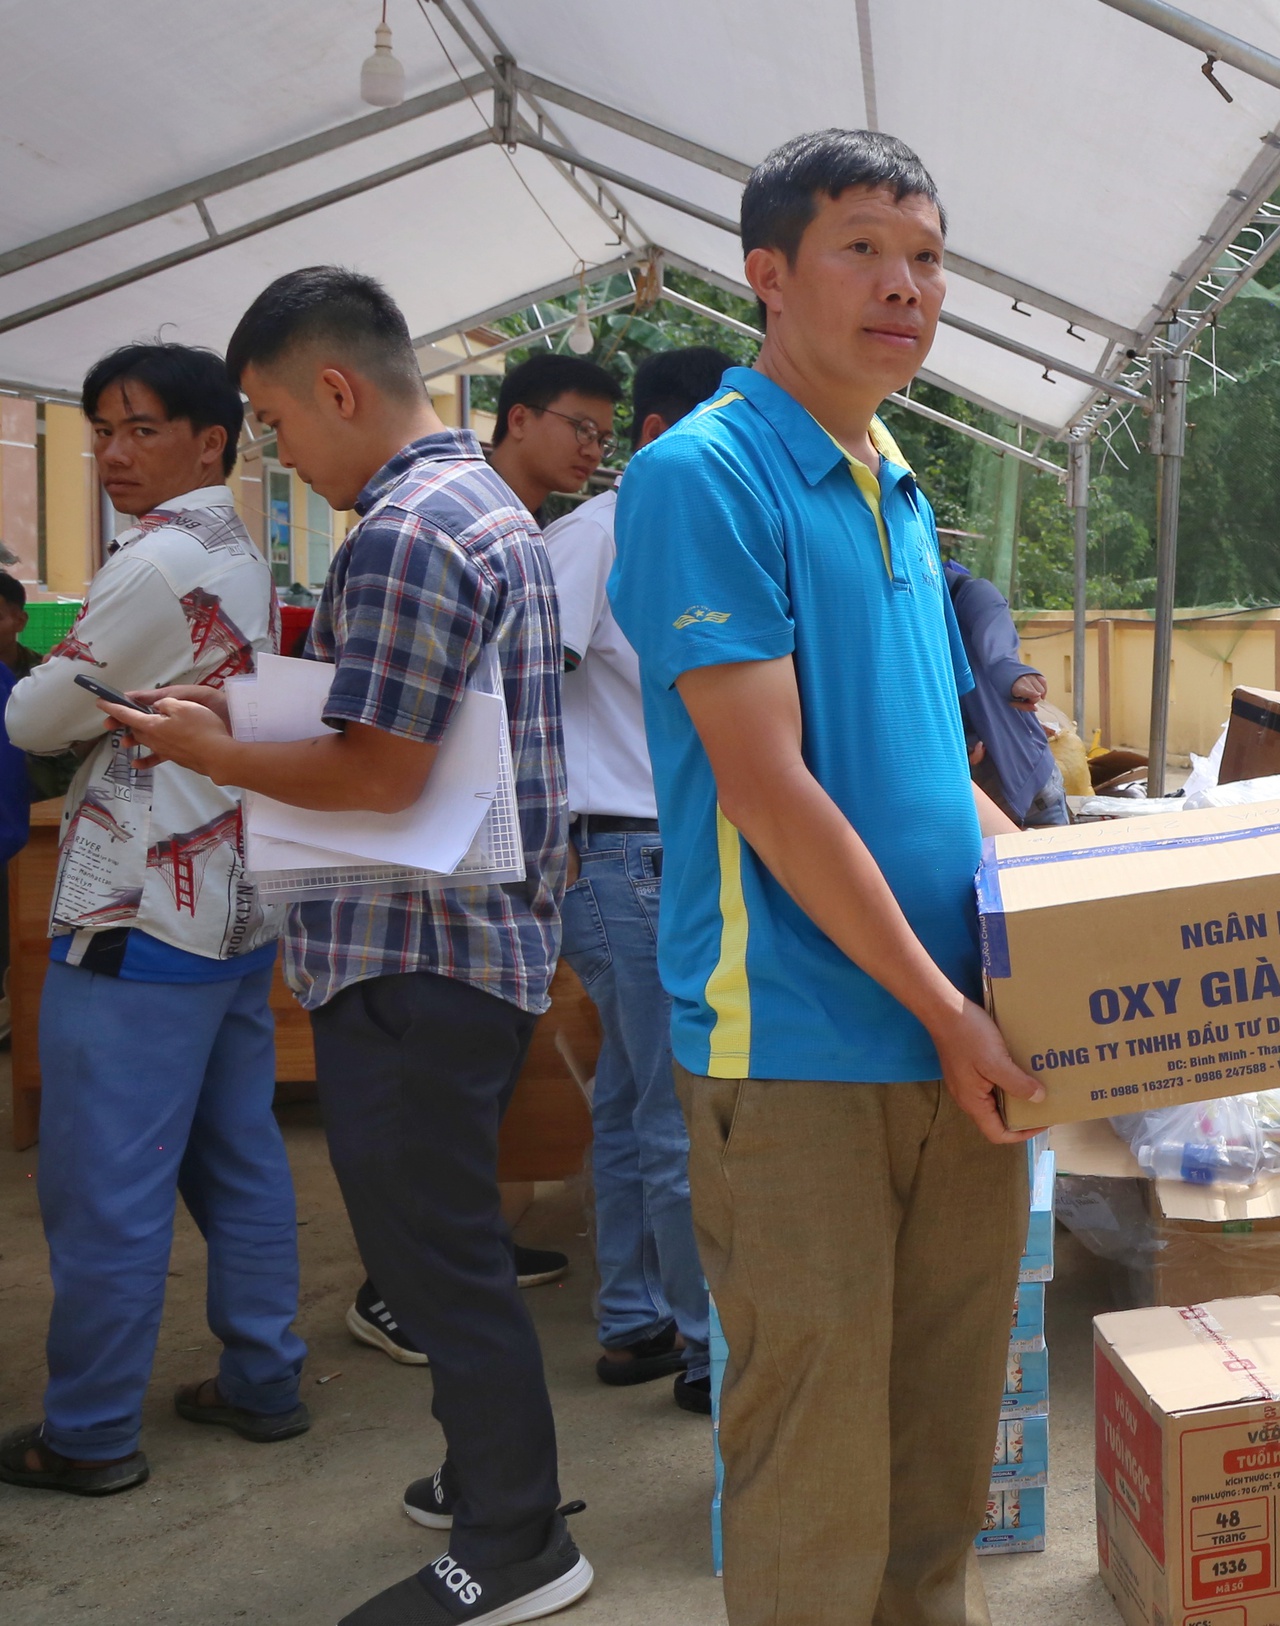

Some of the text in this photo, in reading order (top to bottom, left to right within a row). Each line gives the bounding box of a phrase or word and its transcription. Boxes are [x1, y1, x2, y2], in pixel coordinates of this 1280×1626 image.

[76, 835, 102, 852] RIVER
[79, 868, 112, 886] Manhattan
[1180, 912, 1268, 949] NGÂN
[1089, 977, 1182, 1025] OXY
[1031, 1047, 1090, 1072] CÔNG
[1095, 1042, 1120, 1061] TY
[1125, 1032, 1182, 1057] TNHH
[1235, 1017, 1262, 1039] TƯ
[1168, 1060, 1187, 1071] ĐC:
[1219, 1049, 1247, 1063] Minh
[1091, 1089, 1108, 1101] ĐT:
[1111, 1084, 1139, 1097] 0986
[1142, 1076, 1184, 1092] 163273
[1195, 1070, 1223, 1083] 0986
[1225, 1062, 1267, 1078] 247588
[1216, 1510, 1240, 1528] 48
[1212, 1558, 1247, 1576] 1336
